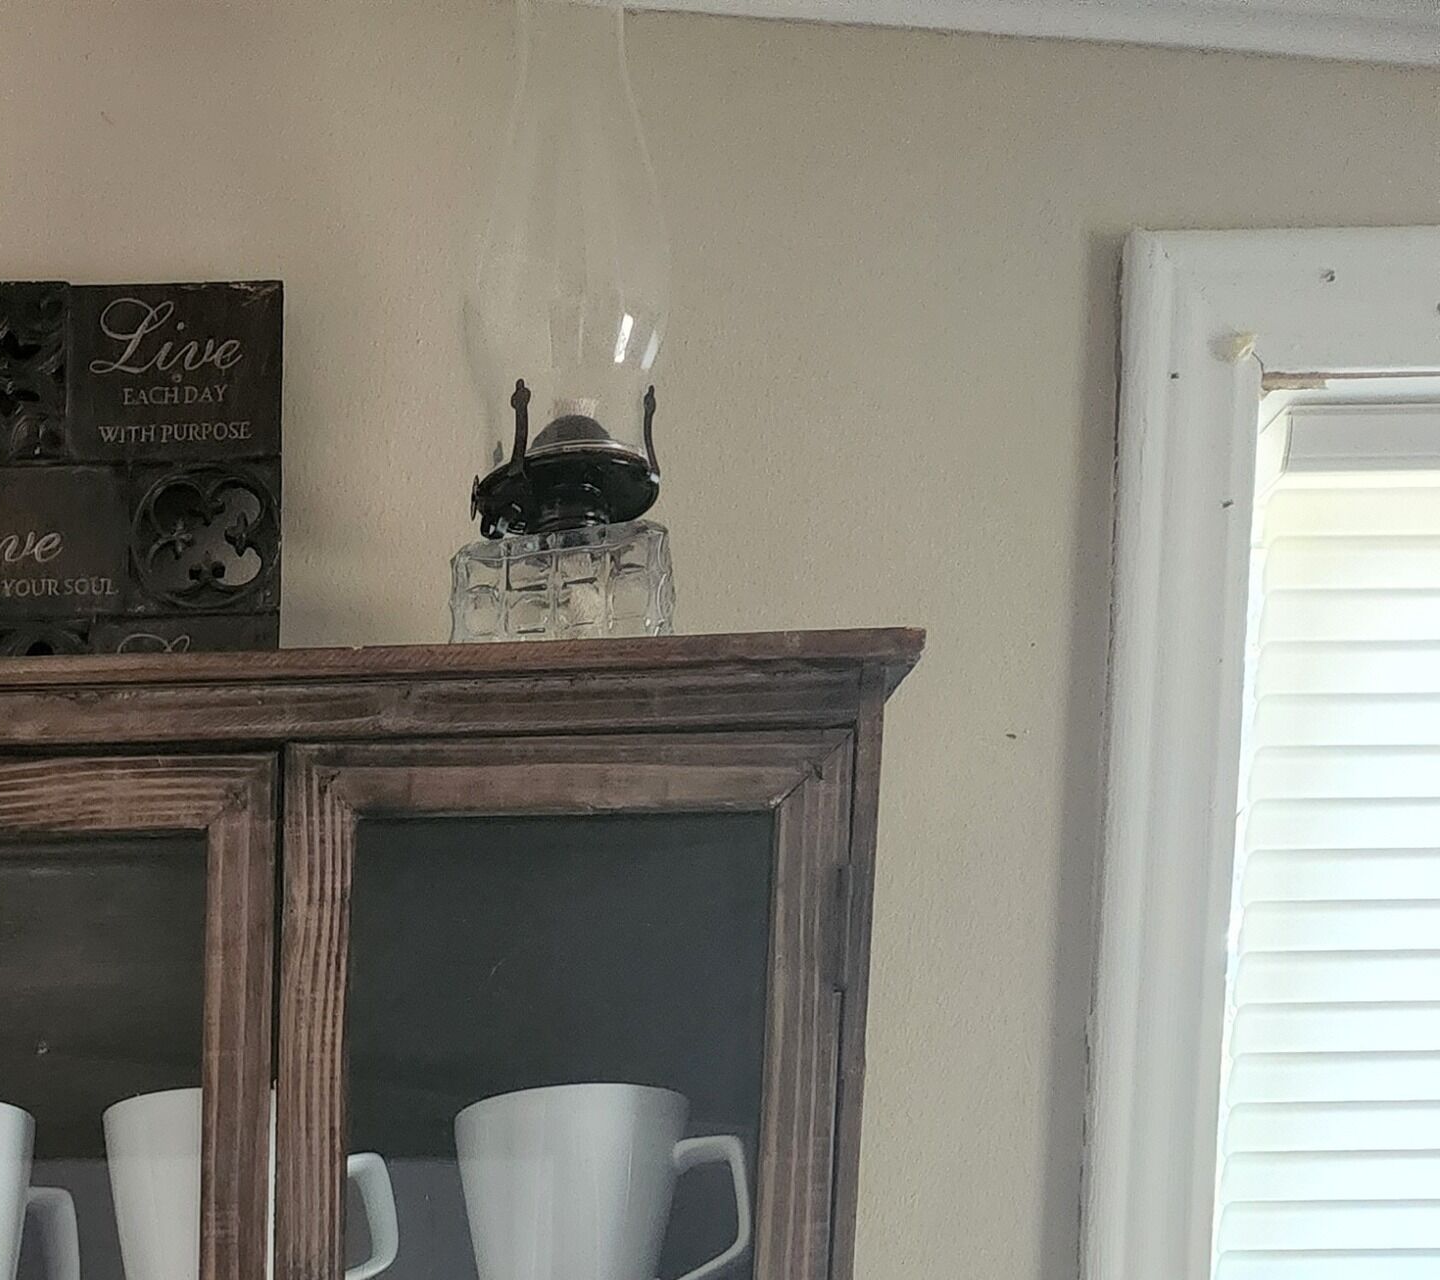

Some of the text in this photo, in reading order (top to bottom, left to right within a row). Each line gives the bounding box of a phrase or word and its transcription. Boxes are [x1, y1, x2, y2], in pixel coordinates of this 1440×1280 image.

[89, 297, 245, 375] Live
[123, 384, 228, 406] EACH DAY
[98, 421, 252, 444] WITH PURPOSE
[2, 578, 60, 597] YOUR
